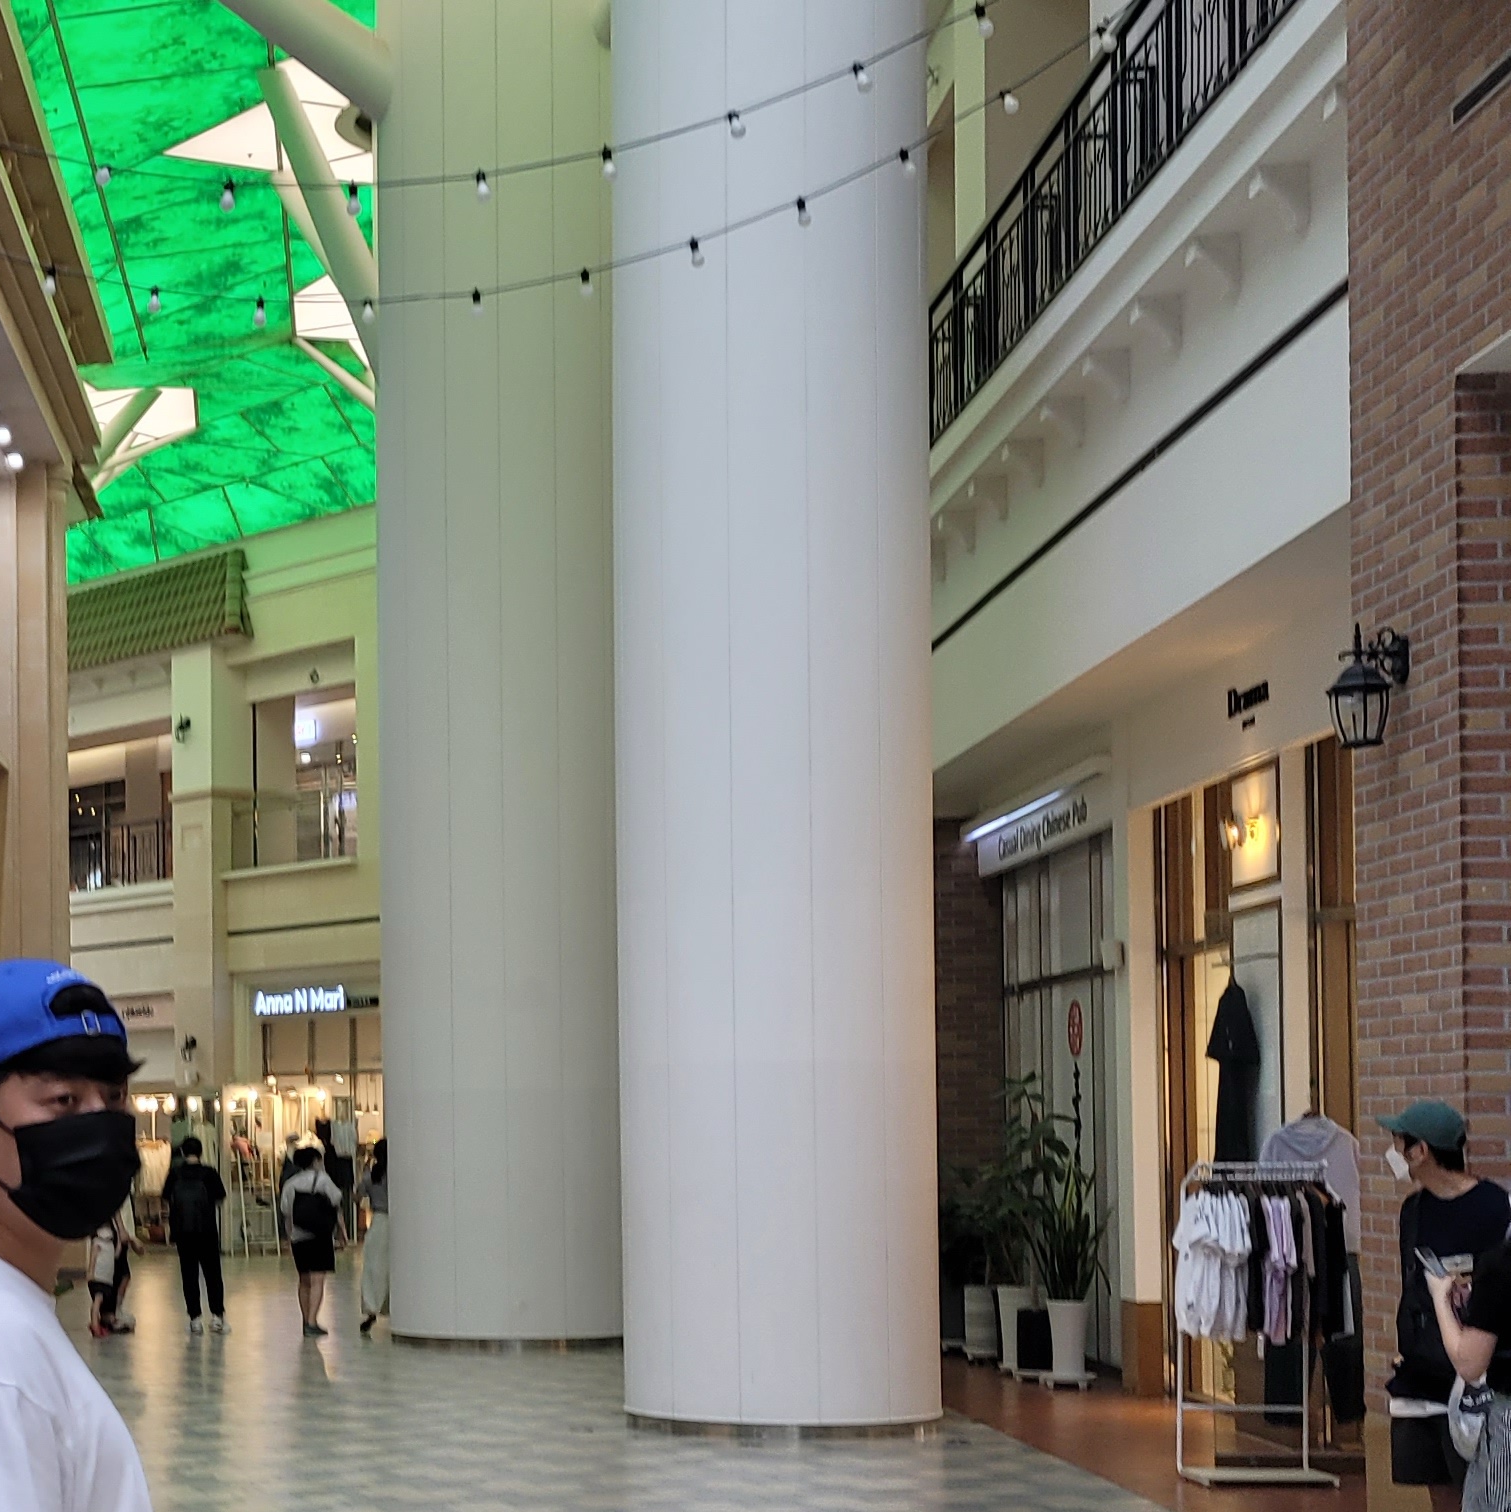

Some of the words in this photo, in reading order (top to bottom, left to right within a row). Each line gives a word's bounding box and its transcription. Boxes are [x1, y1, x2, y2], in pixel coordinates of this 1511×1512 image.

[1227, 680, 1269, 719] Drama
[998, 826, 1019, 860] Casual
[1019, 820, 1042, 851] Dining
[1042, 807, 1071, 841] Chinese
[1072, 794, 1088, 828] Pub
[255, 990, 293, 1016] Anna
[294, 987, 308, 1014] N
[309, 984, 345, 1013] Mari
